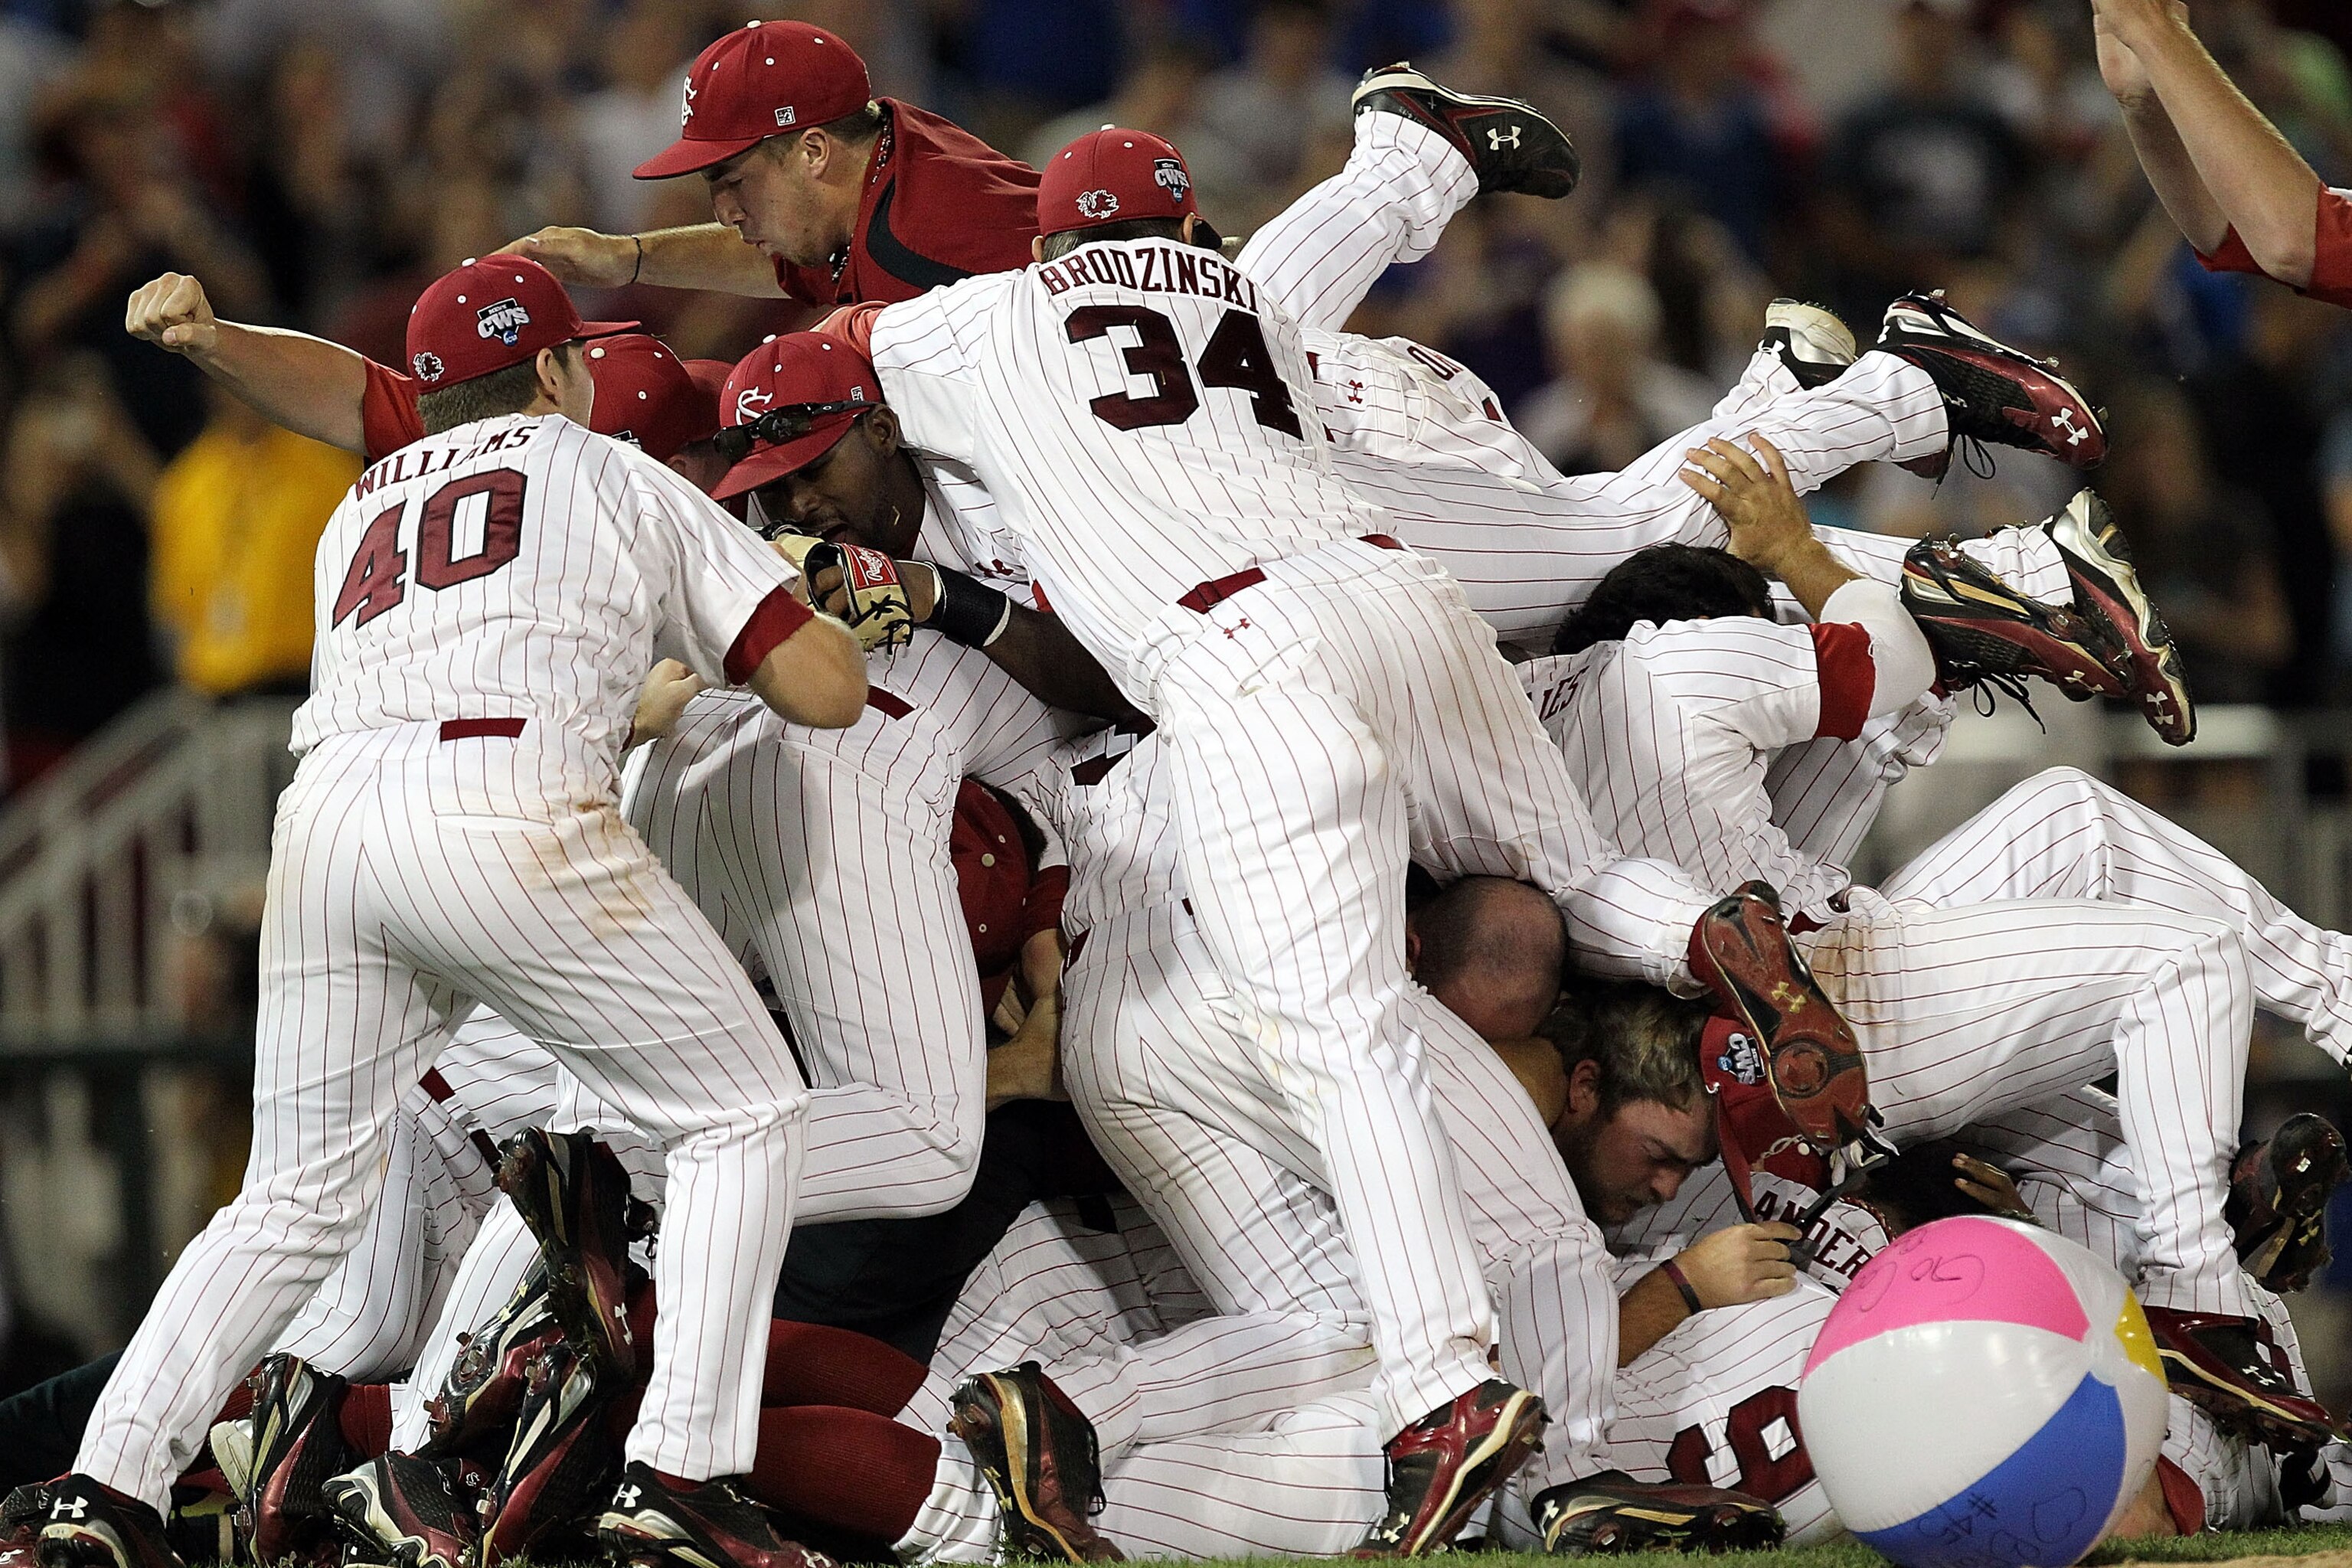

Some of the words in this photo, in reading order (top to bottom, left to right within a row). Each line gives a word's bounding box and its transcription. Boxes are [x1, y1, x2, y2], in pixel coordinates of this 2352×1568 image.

[1155, 168, 1190, 188] CWS
[1038, 247, 1259, 314] BRODZINSKI
[478, 306, 530, 338] CWS
[1064, 305, 1305, 442] 34
[332, 467, 528, 632] 40
[1729, 1033, 1756, 1085] CWS
